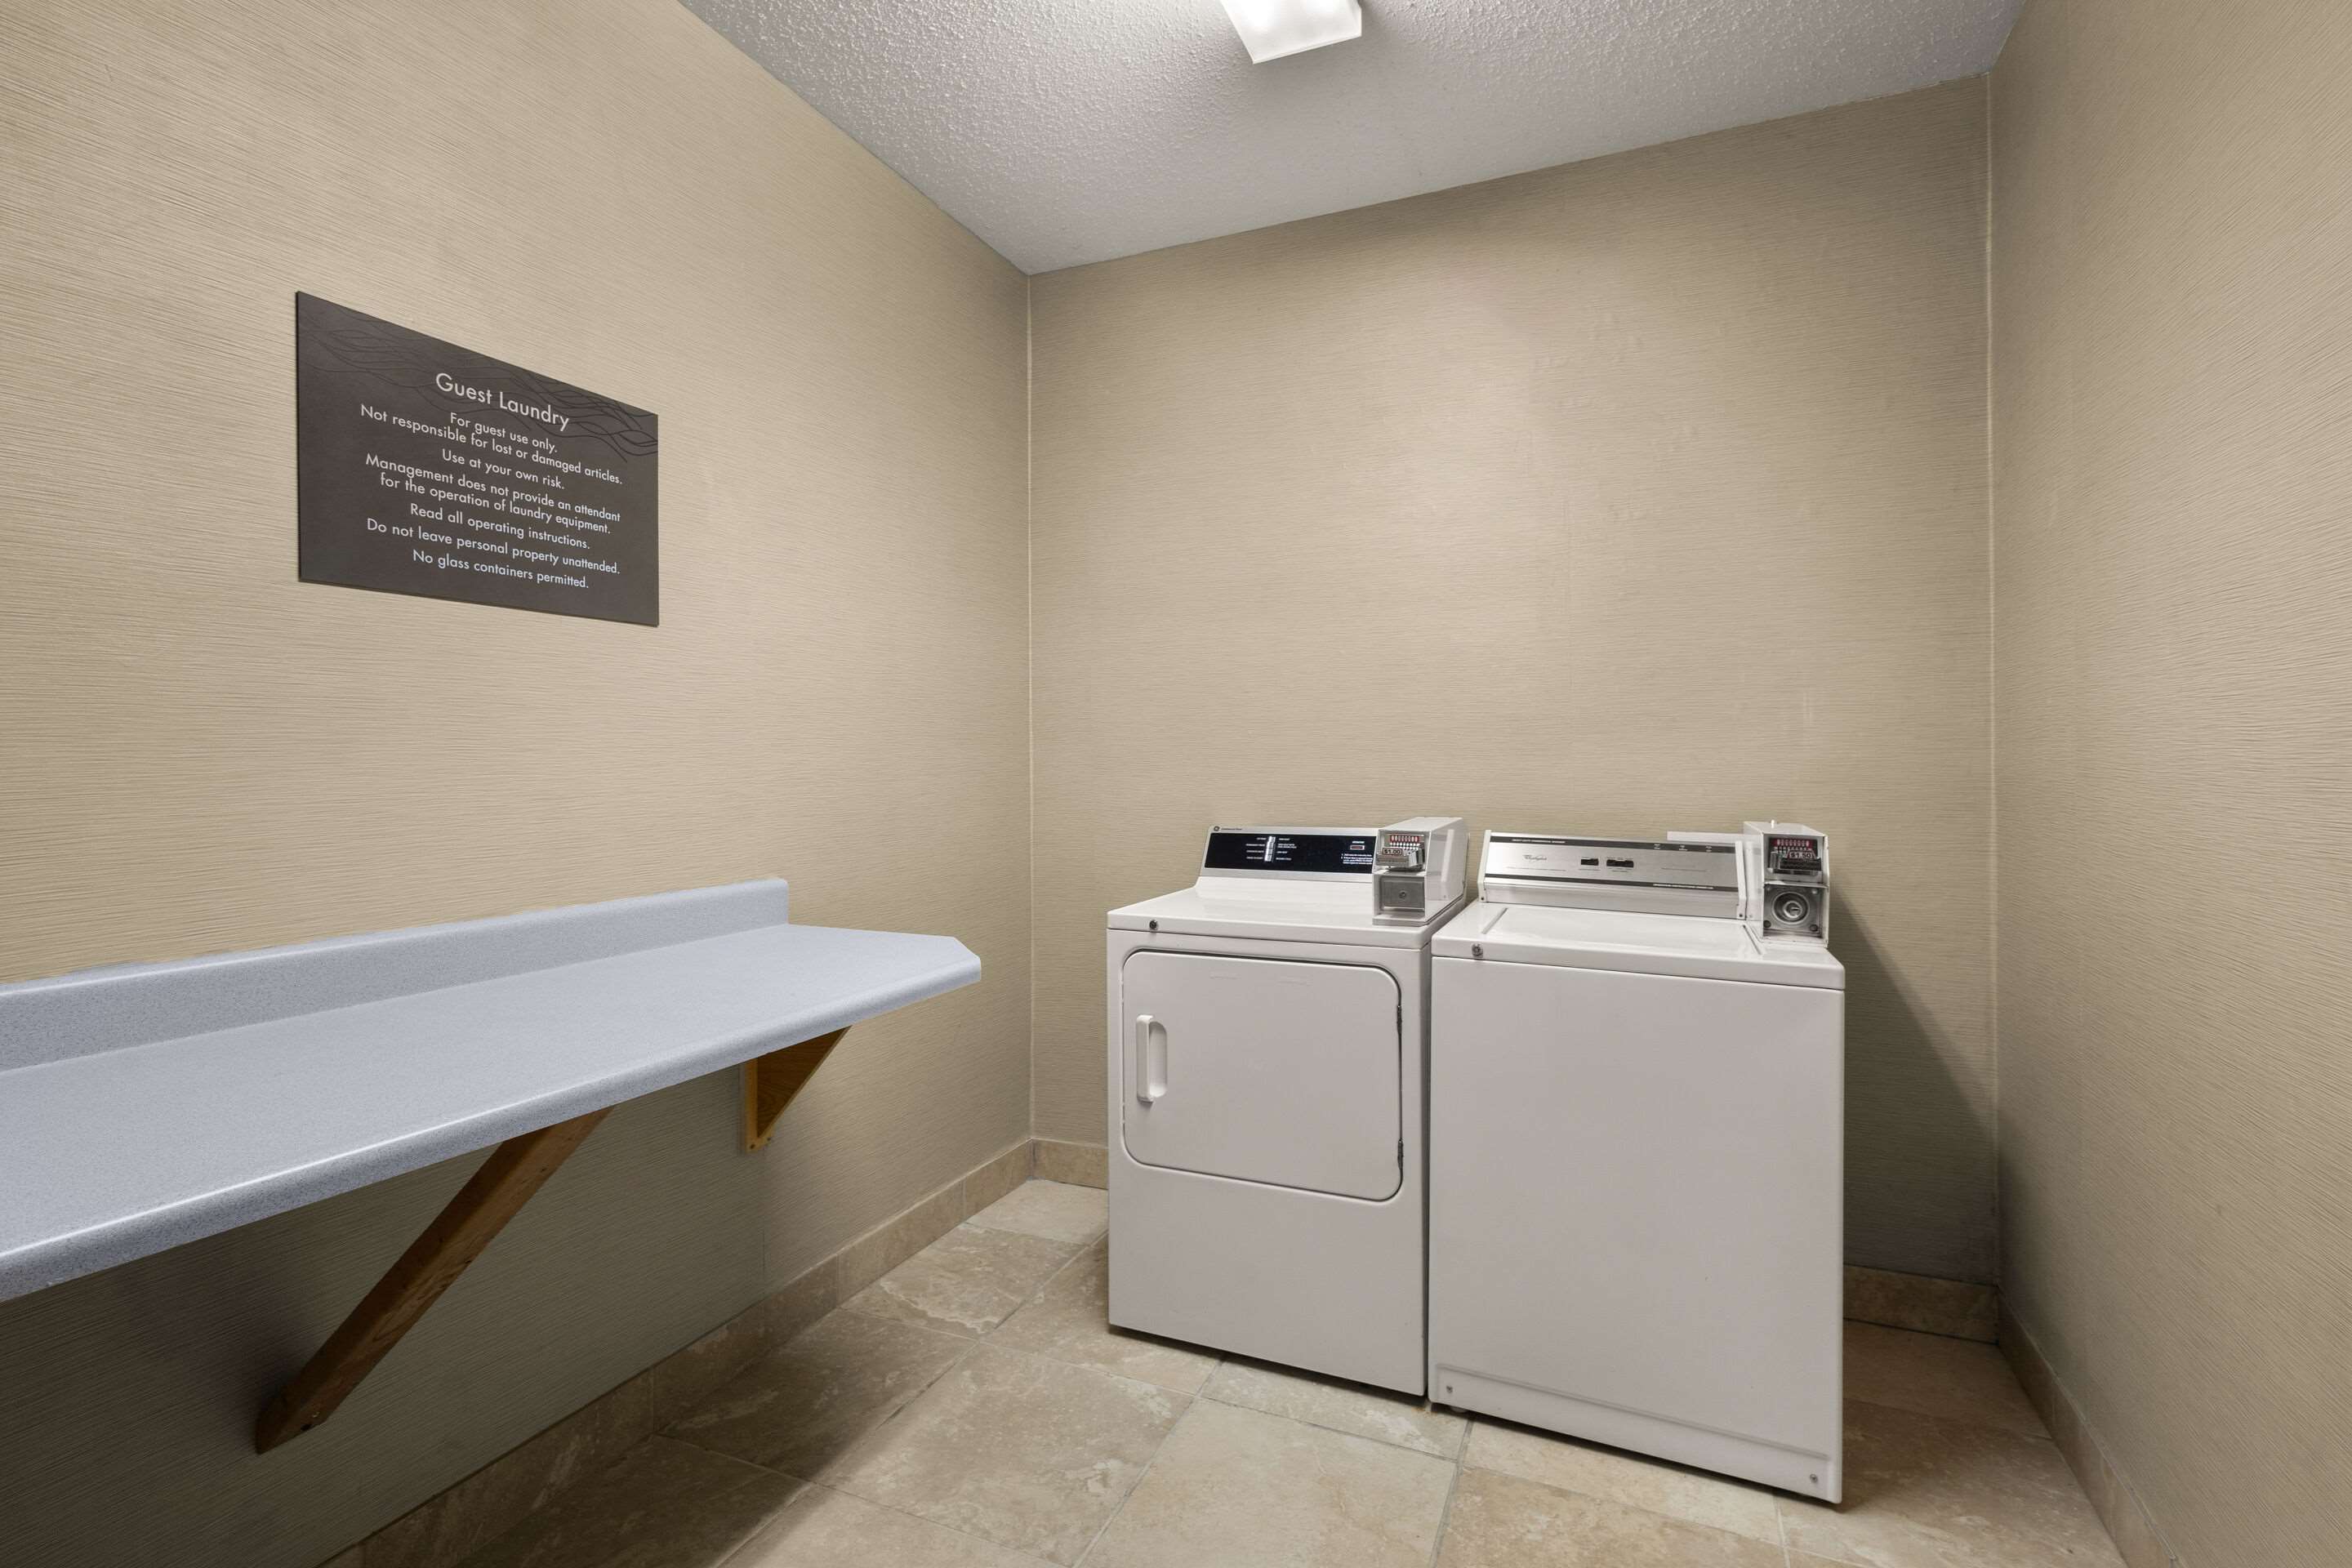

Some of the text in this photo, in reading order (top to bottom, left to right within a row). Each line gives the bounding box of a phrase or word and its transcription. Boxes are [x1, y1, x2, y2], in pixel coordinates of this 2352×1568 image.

[435, 372, 569, 431] Guest Laundry
[361, 403, 623, 484] Not responsible for lost or damaged articles.
[450, 412, 558, 454] For guest use only.
[365, 452, 621, 522] Management does not provide an attendant
[442, 448, 565, 489] Use at your own risk.
[381, 471, 611, 534] for the operation of laundry equipment.
[410, 502, 590, 550] Read all operating instructions.
[367, 518, 621, 574] Do not leave personal property unattended.
[412, 549, 589, 588] No glass containers permitted.
